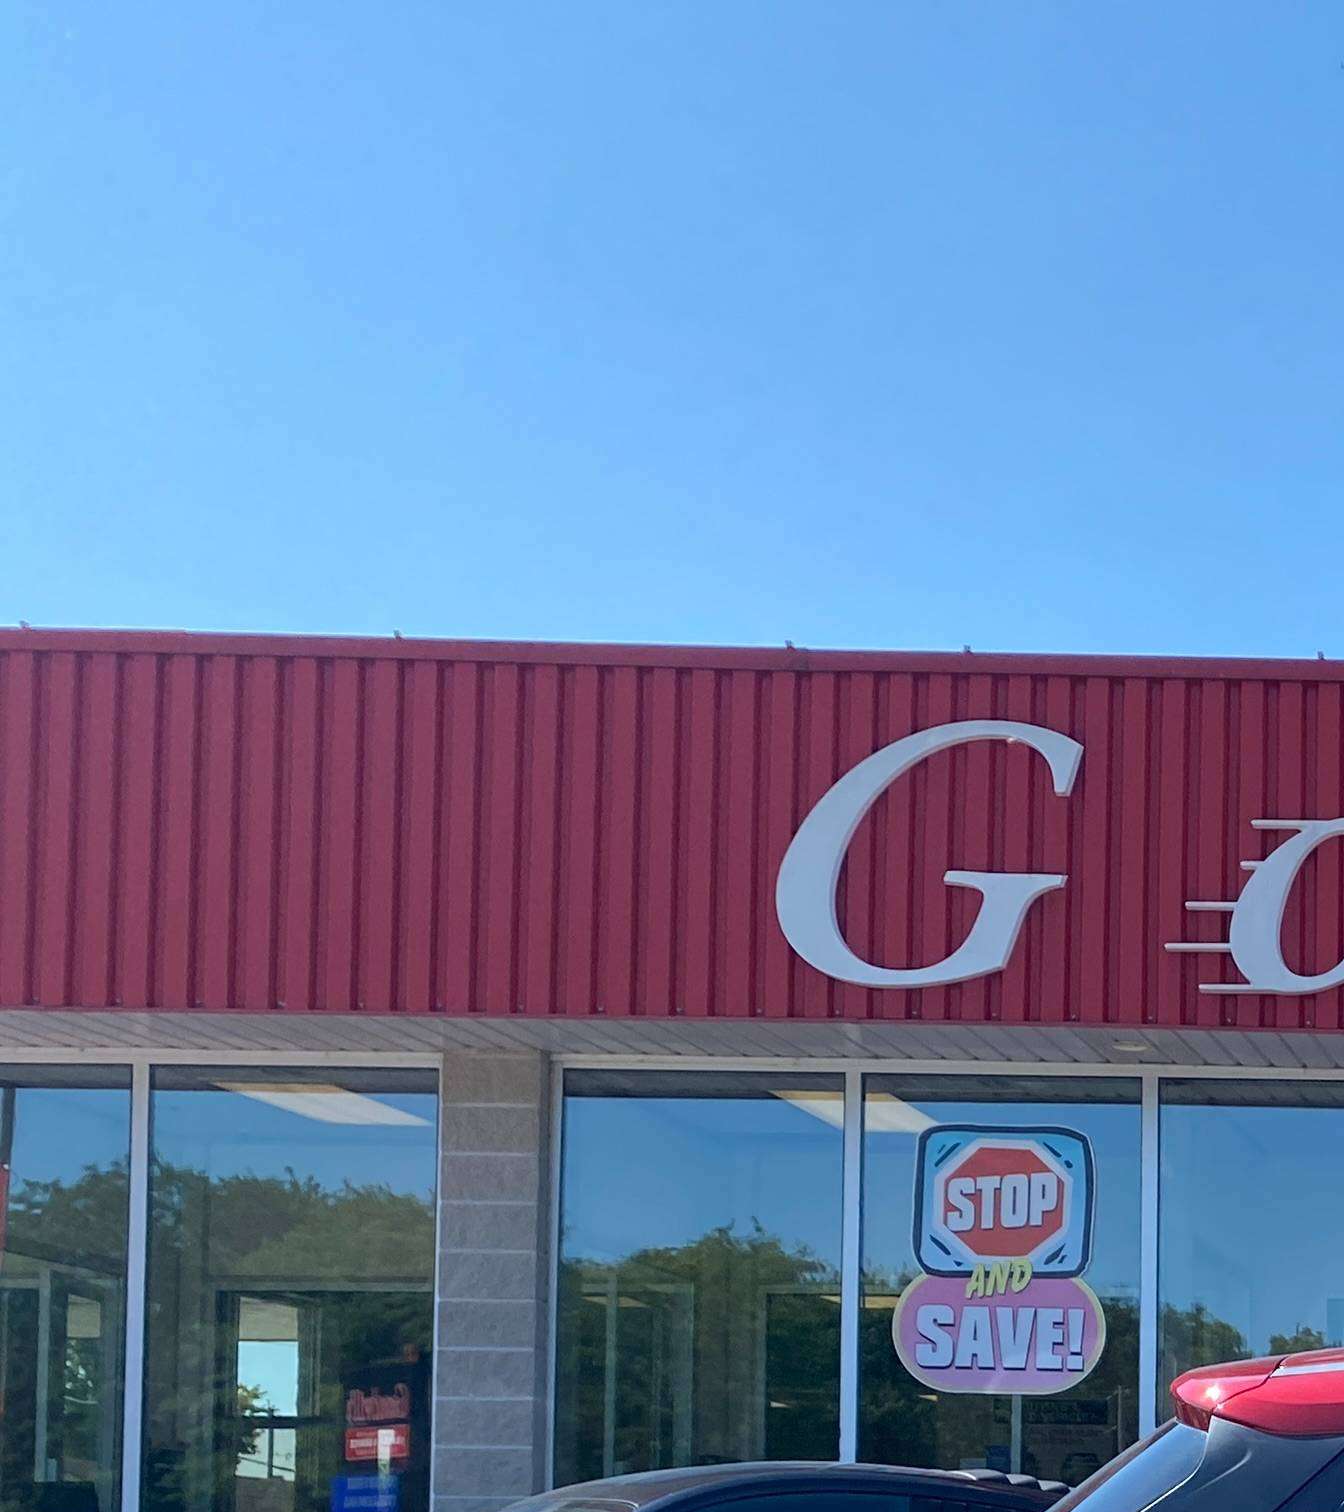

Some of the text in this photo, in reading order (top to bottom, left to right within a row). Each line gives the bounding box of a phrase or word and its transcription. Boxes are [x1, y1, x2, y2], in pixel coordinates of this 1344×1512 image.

[946, 1172, 1059, 1232] STOP
[965, 1258, 1033, 1300] AND
[915, 1303, 1086, 1371] SAVE!
